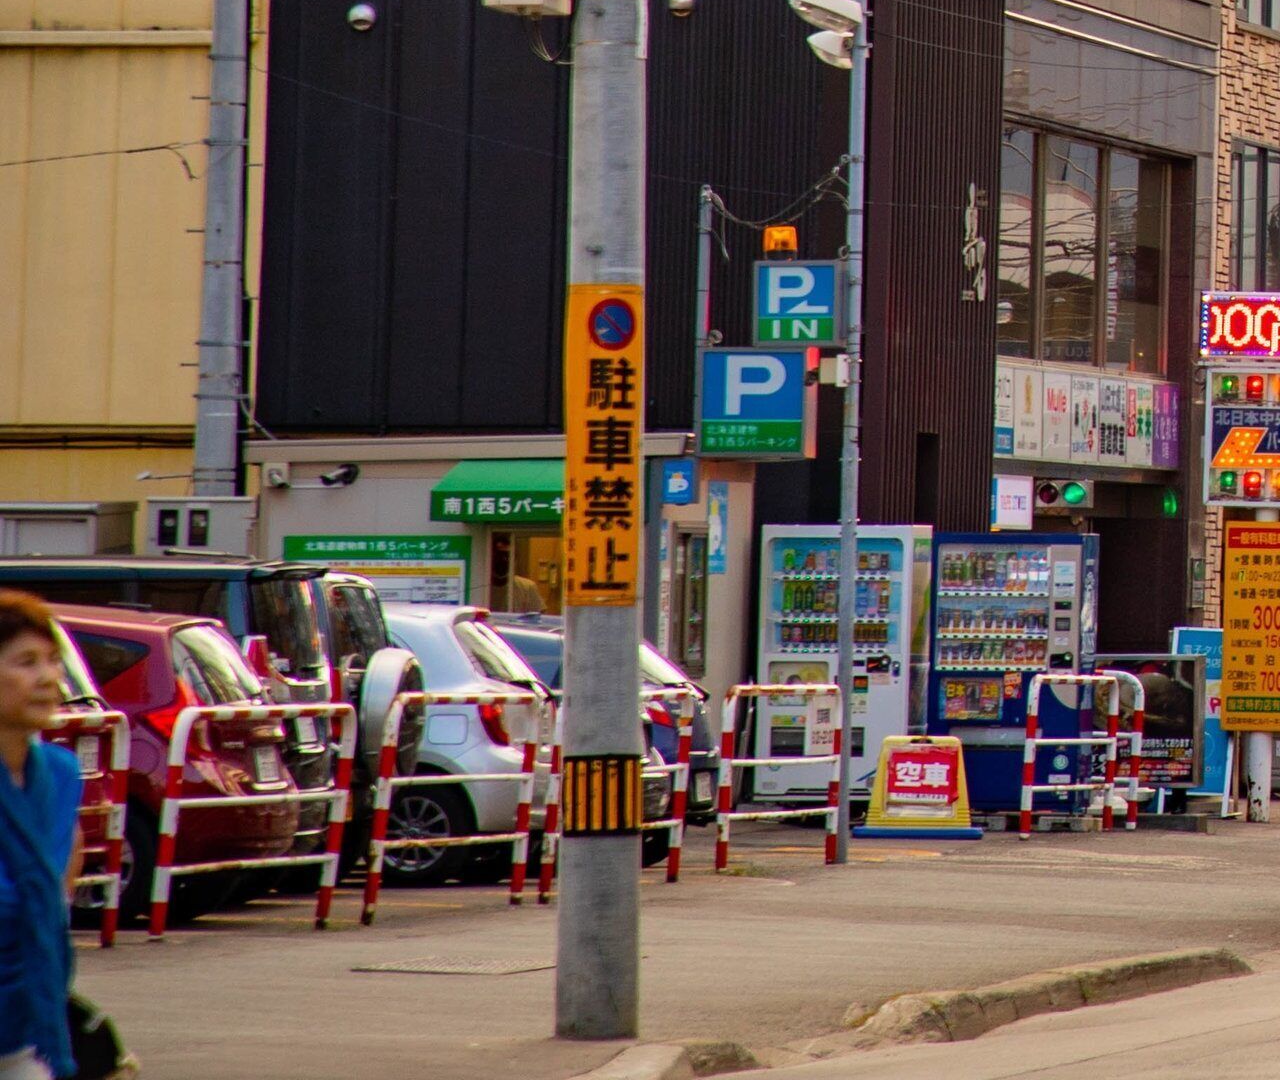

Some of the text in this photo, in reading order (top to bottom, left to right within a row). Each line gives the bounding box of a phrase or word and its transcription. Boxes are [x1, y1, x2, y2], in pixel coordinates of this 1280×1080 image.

[768, 266, 815, 314] P
[771, 318, 818, 340] IN
[725, 354, 787, 416] P
[581, 357, 637, 590] 駐車禁止
[895, 760, 950, 788] 空車
